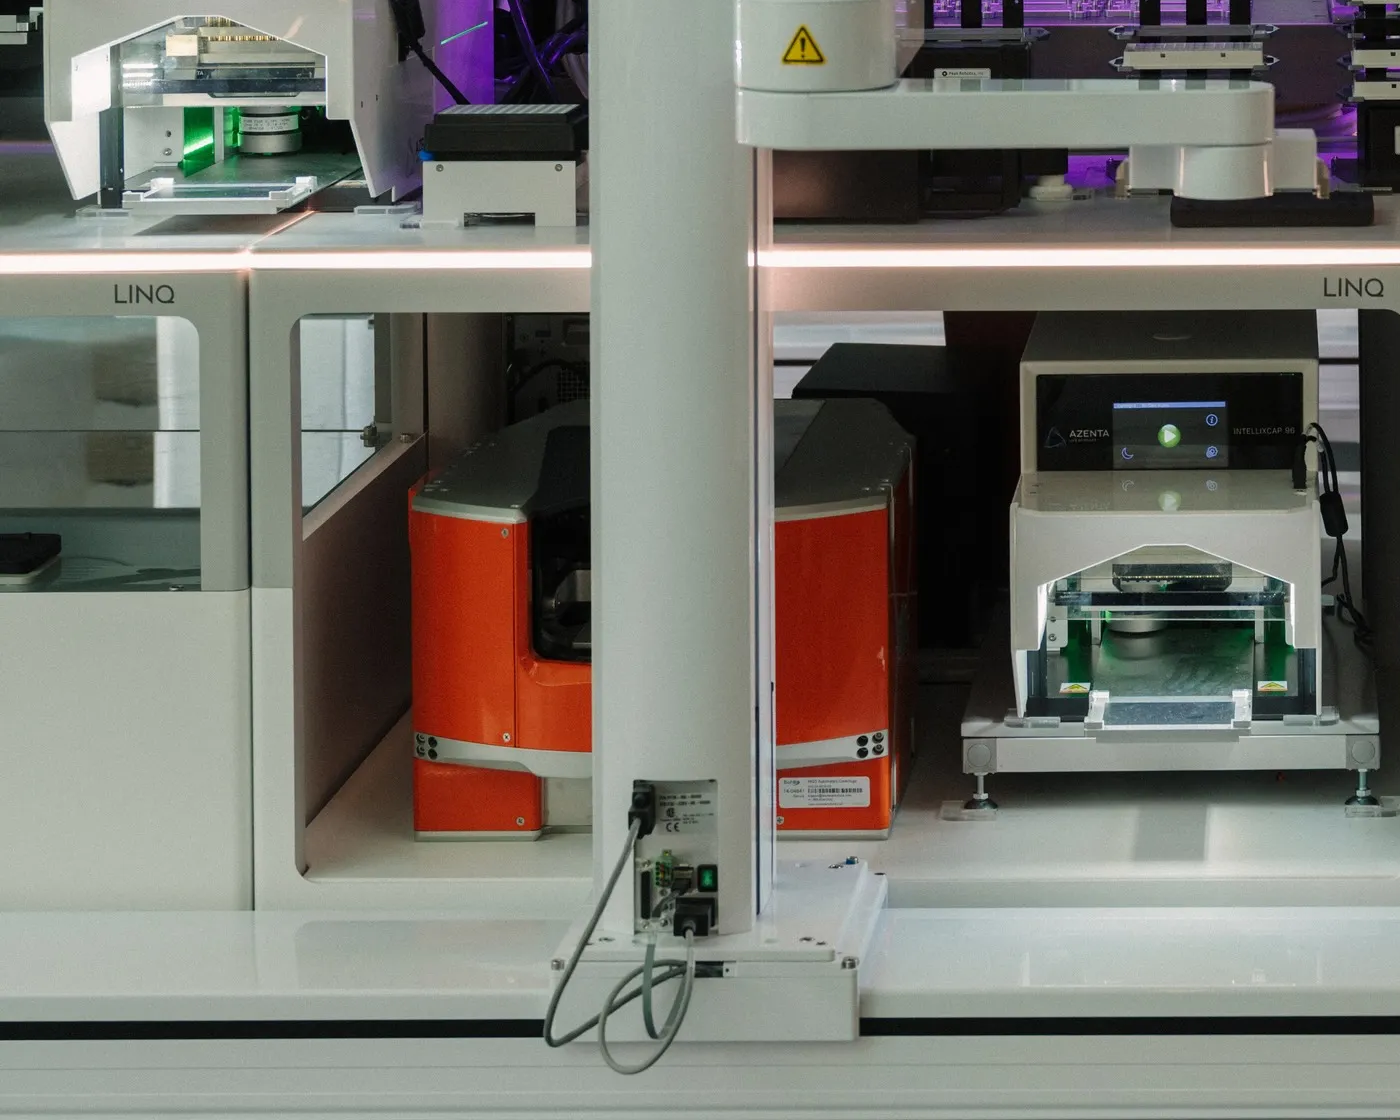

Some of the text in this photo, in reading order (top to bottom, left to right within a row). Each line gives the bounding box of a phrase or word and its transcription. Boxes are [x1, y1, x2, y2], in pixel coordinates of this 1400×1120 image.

[113, 283, 175, 304] LINQ
[1323, 277, 1384, 297] LINQ
[1069, 429, 1110, 438] AZENTA
[1233, 426, 1296, 435] INTELLIXCAP 96
